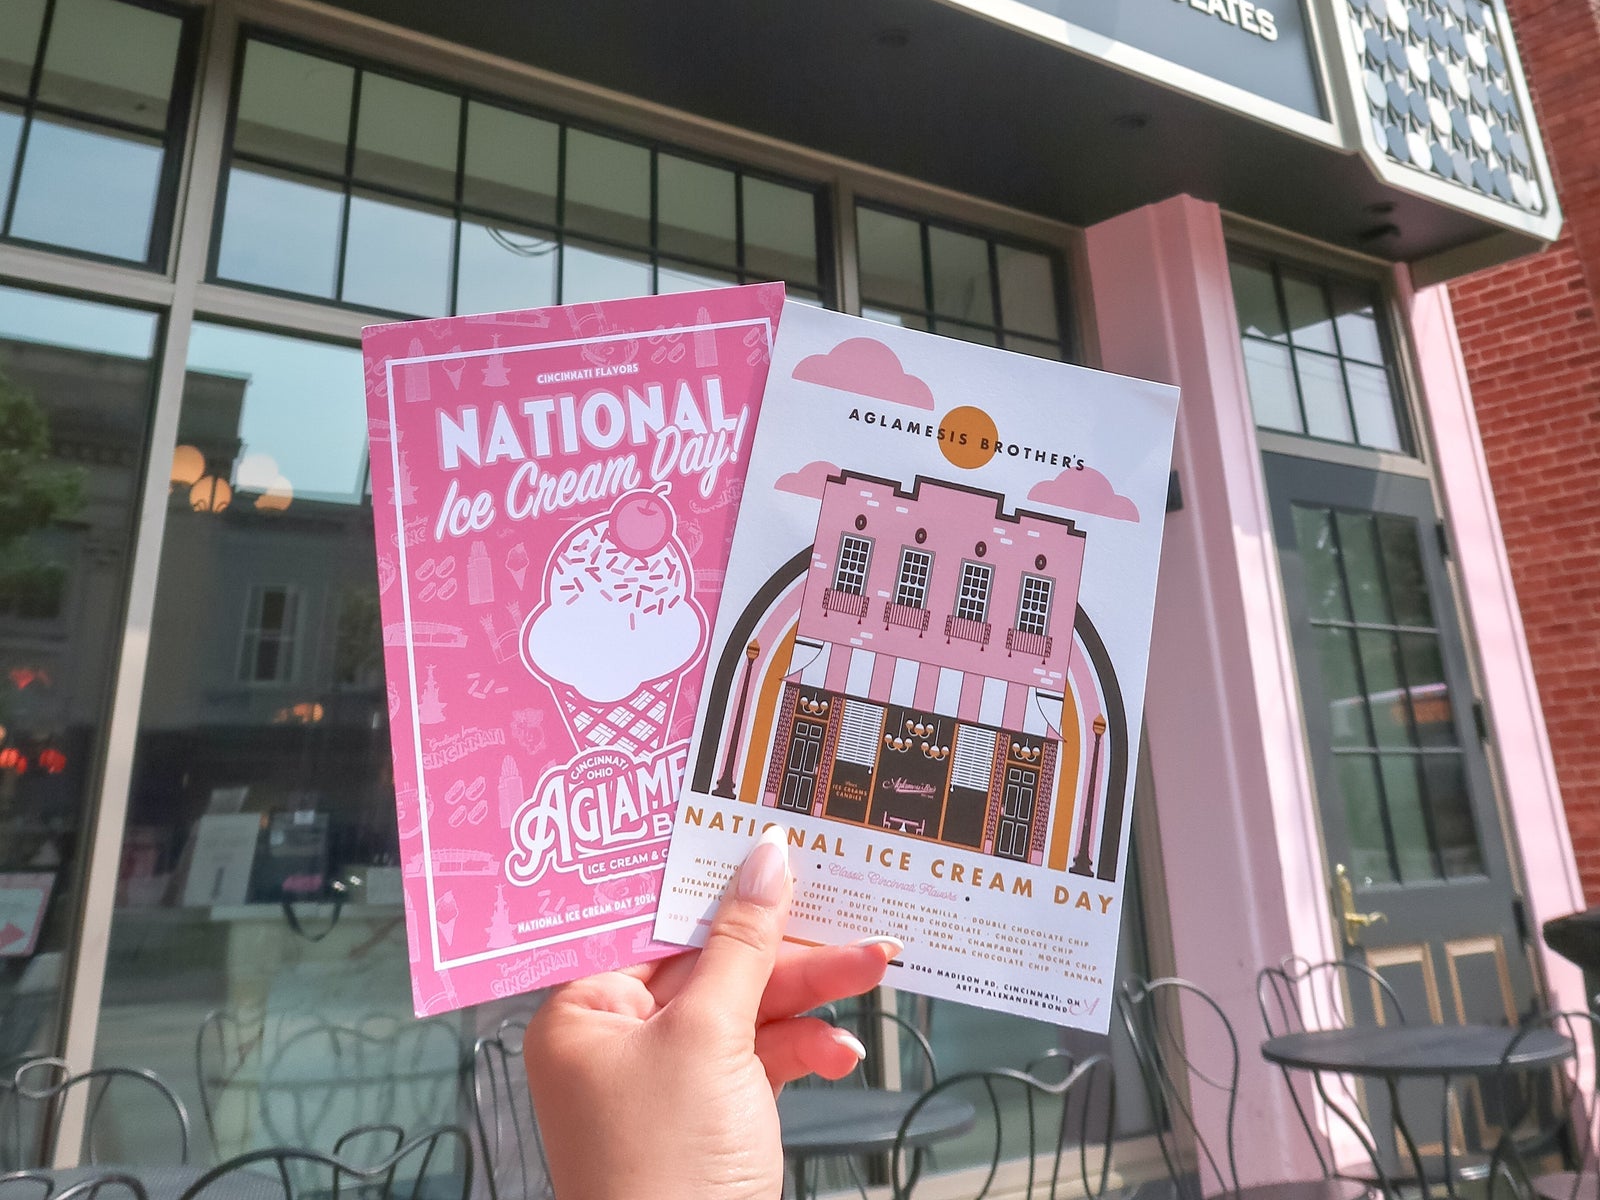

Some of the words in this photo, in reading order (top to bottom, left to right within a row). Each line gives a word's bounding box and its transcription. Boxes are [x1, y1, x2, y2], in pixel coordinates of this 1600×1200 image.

[537, 369, 593, 384] CINCINNATI
[595, 363, 639, 377] FLAVORS
[438, 377, 740, 469] NATIONAL
[848, 407, 969, 446] AGLAMESIS
[980, 437, 1085, 472] BROTHER'S
[436, 481, 495, 540] Ice
[507, 452, 640, 519] Cream
[651, 404, 749, 497] Day!
[571, 755, 629, 780] CINCINNATI
[586, 767, 614, 780] OHIO
[588, 863, 606, 875] ICE
[609, 852, 649, 870] CREAM
[651, 850, 659, 861] &
[828, 862, 865, 882] Classic
[919, 882, 958, 902] Flavors
[865, 844, 912, 871] ICE
[930, 858, 1033, 898] CREAM
[1053, 884, 1114, 915] DAY
[518, 915, 564, 934] NATIONAL
[565, 910, 582, 923] ICE
[582, 902, 613, 919] CREAM
[614, 898, 632, 912] DAY
[634, 894, 657, 907] 2024
[695, 857, 717, 868] MINT
[811, 882, 839, 894] FRESH
[843, 888, 871, 901] PEACH
[881, 896, 916, 910] FRENCH
[920, 905, 958, 920] VANILLA
[972, 916, 1007, 931] DOUBLE
[1011, 925, 1064, 943] CHOCOLATE
[1068, 937, 1090, 948] CHIP
[803, 890, 835, 904] COFFEE
[849, 900, 878, 913] DUTCH
[882, 908, 925, 923] HOLLAND
[929, 918, 982, 936] CHOCOLATE
[995, 932, 1049, 950] CHOCOLATE
[1052, 945, 1074, 955] CHIP
[672, 886, 704, 898] BUTTER
[837, 920, 890, 937] CHOCOLATE
[895, 932, 916, 943] CHIP
[929, 940, 968, 955] BANANA
[971, 949, 1025, 968] CHOCOLATE
[1028, 961, 1050, 973] CHIP
[1064, 970, 1104, 985] BANANA
[837, 909, 874, 923] ORANGE
[888, 921, 909, 931] LIME
[923, 927, 954, 941] LEMON
[968, 938, 1024, 956] CHAMPAGNE
[1038, 953, 1071, 967] MOCHA
[1075, 961, 1098, 972] CHIP
[909, 963, 933, 975] 3046
[936, 969, 980, 985] MADISON
[1004, 984, 1062, 1003] CINCINNATI,
[1067, 997, 1081, 1007] OH
[956, 983, 973, 993] ART
[975, 987, 986, 995] BY
[986, 988, 1040, 1008] ALEXANDER
[1041, 1001, 1069, 1014] BOND
